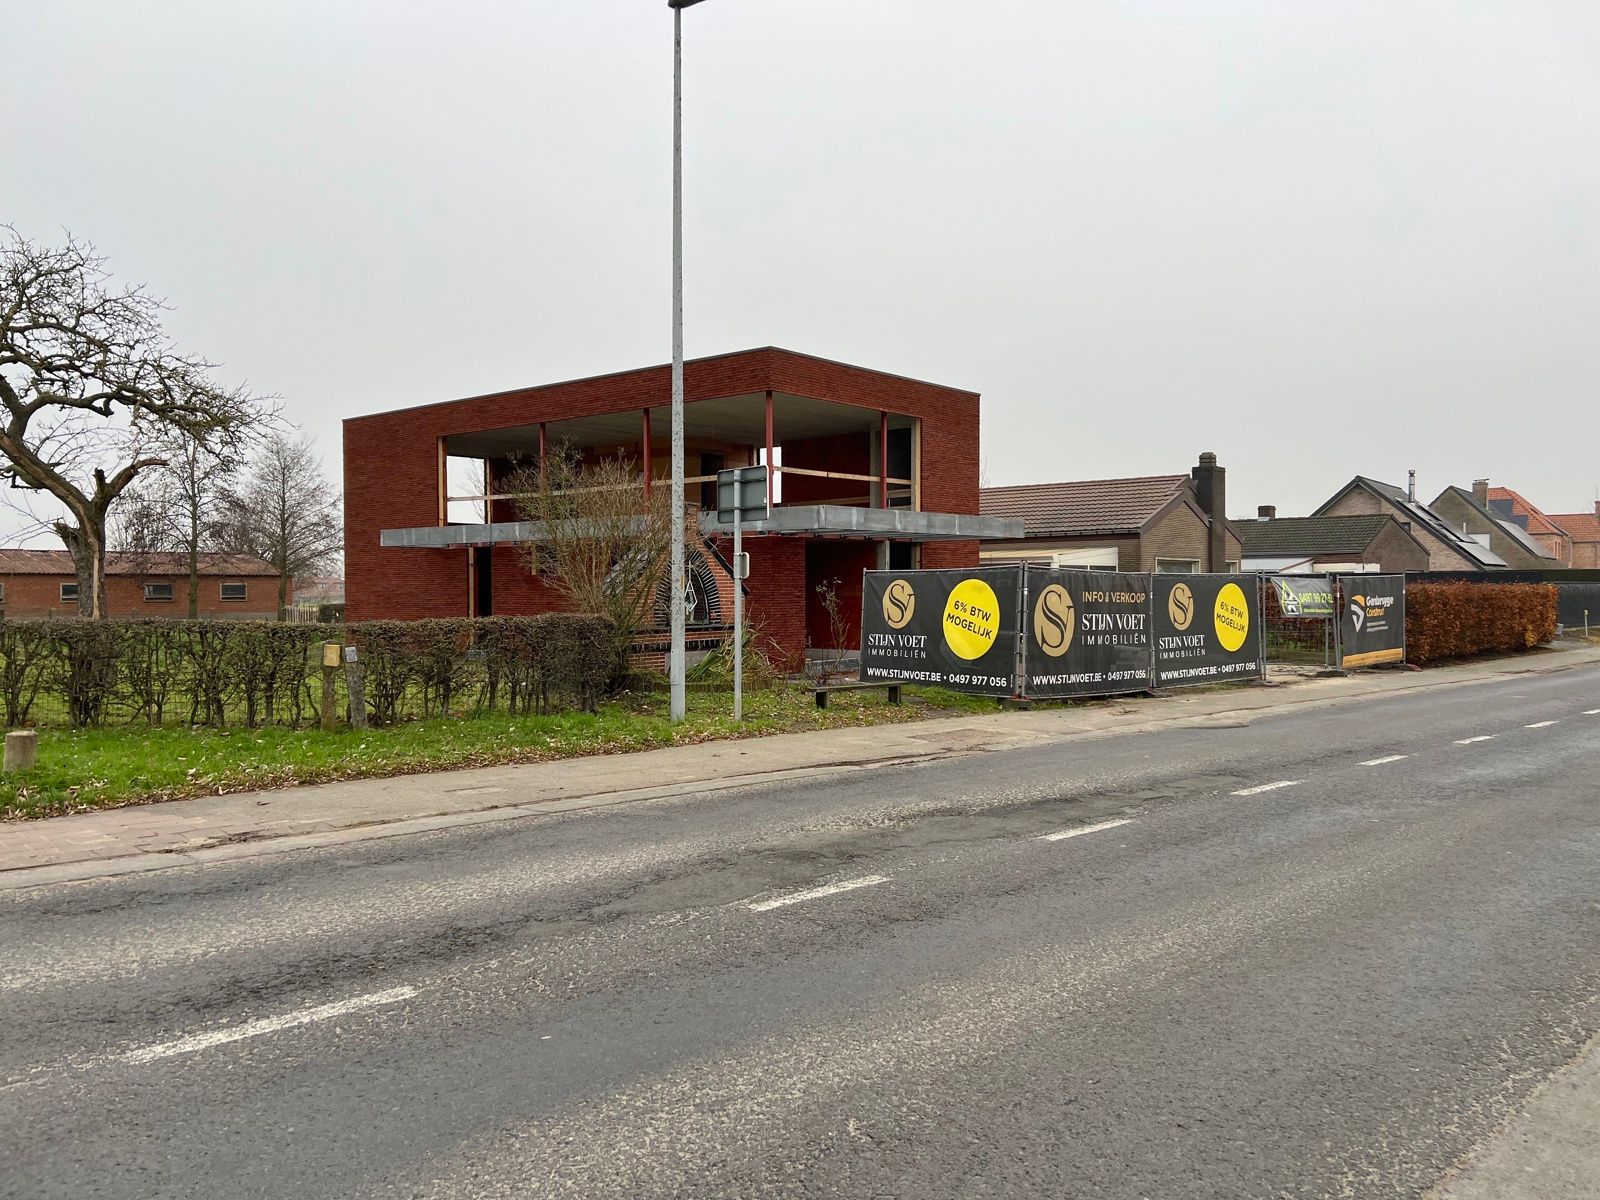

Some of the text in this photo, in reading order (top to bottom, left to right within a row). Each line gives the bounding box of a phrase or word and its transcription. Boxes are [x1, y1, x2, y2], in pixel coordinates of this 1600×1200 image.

[1082, 591, 1103, 603] INFO
[1111, 592, 1146, 604] VERKOOP
[953, 600, 992, 623] 6% BTW
[1220, 601, 1244, 619] 6% BTW
[945, 612, 993, 640] MOGELIJK
[1081, 613, 1146, 631] STIJN VOET
[1215, 612, 1246, 634] MOGELIJK
[868, 633, 927, 648] STIJN VOET
[1081, 633, 1146, 646] IMMOBILIËN
[1159, 634, 1205, 650] STIJN VOET
[868, 647, 927, 659] IMMOBILIËN
[867, 667, 942, 682] WWW.STIJNVOET.BE
[949, 673, 970, 684] 0497
[971, 675, 987, 686] 977
[990, 676, 1007, 687] 056
[1032, 672, 1102, 686] WWW.STIJNVOET.BE
[1107, 670, 1123, 681] 0497
[1123, 670, 1134, 680] 977
[1160, 662, 1256, 681] WWW.STIJNVOET.BE 0497 977 056
